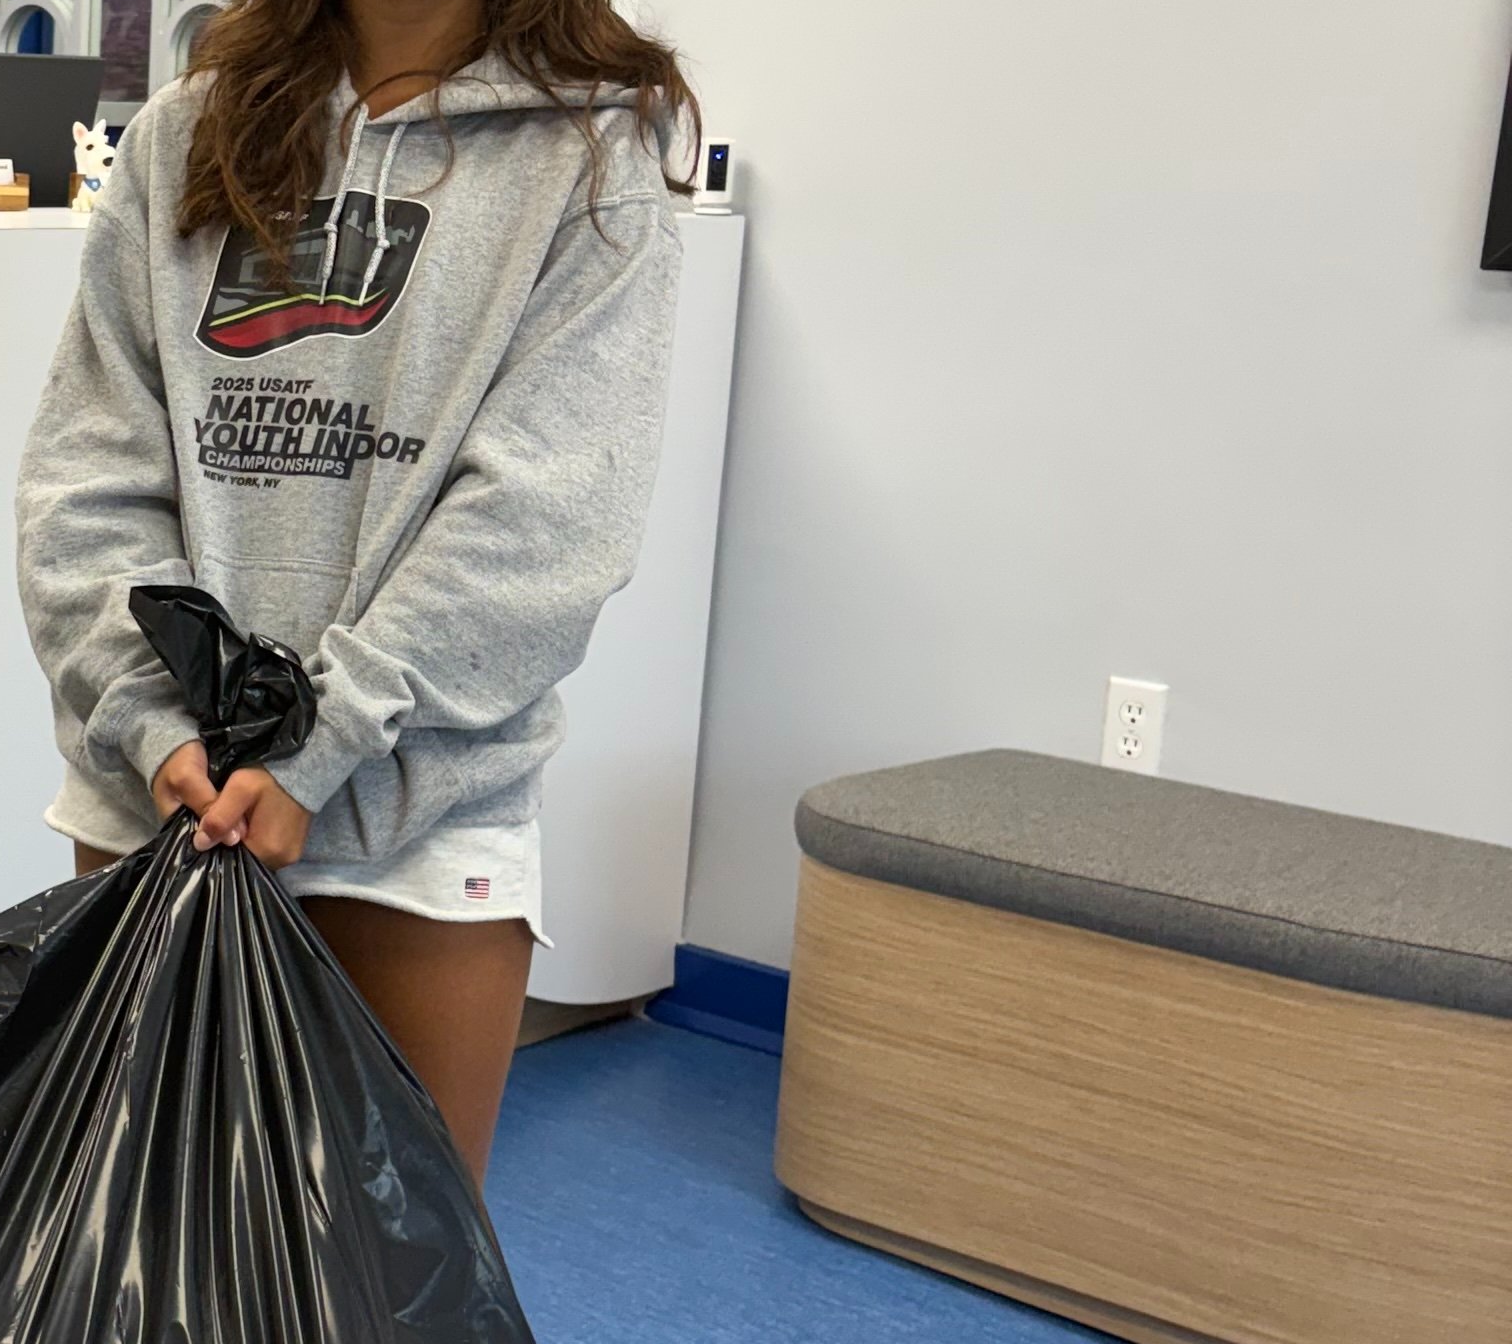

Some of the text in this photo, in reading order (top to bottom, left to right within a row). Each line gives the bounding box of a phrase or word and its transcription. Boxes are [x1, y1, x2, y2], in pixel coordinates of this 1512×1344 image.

[211, 377, 314, 394] 2025 USATF
[206, 395, 377, 431] NATIONAL
[194, 417, 304, 455] YOUTH
[205, 450, 345, 475] CHAMPIONSHIPS
[203, 470, 281, 489] NEW YORK, NY
